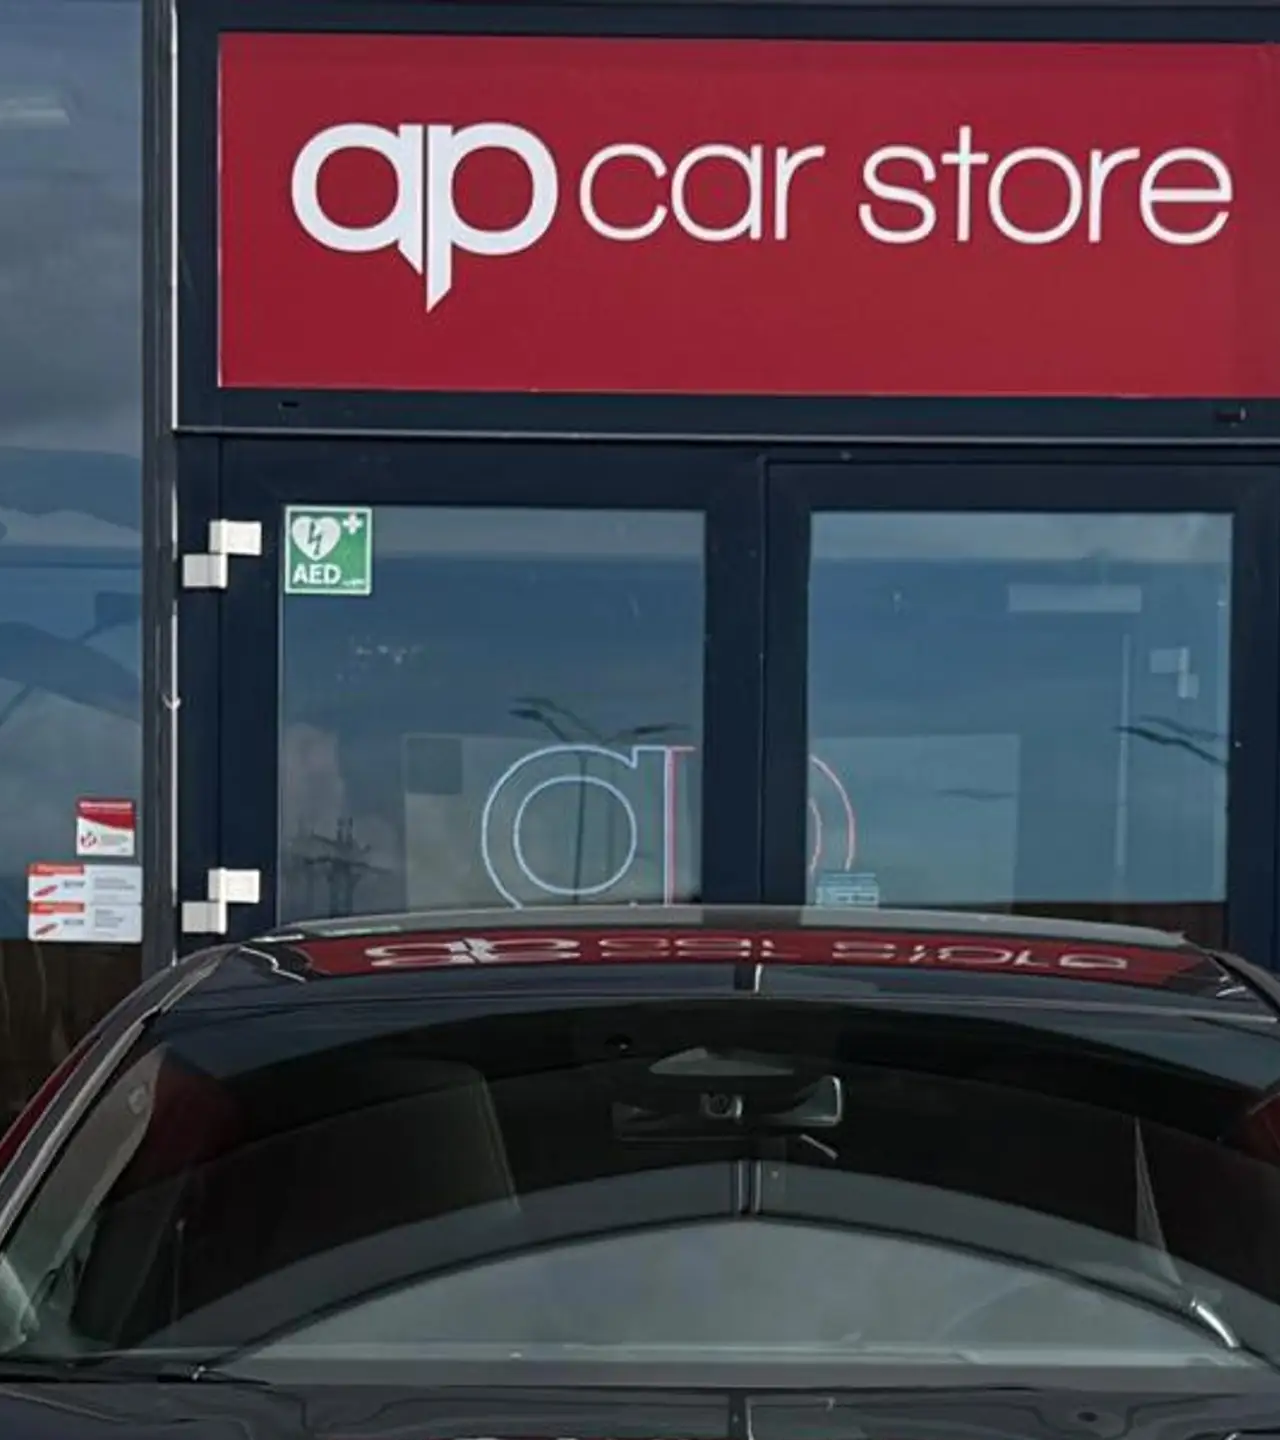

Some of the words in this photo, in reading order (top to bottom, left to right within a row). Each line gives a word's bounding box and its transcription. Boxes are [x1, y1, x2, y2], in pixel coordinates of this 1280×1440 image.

[291, 122, 559, 312] ap
[579, 143, 826, 242] car
[858, 125, 1233, 245] store
[292, 563, 342, 585] AED
